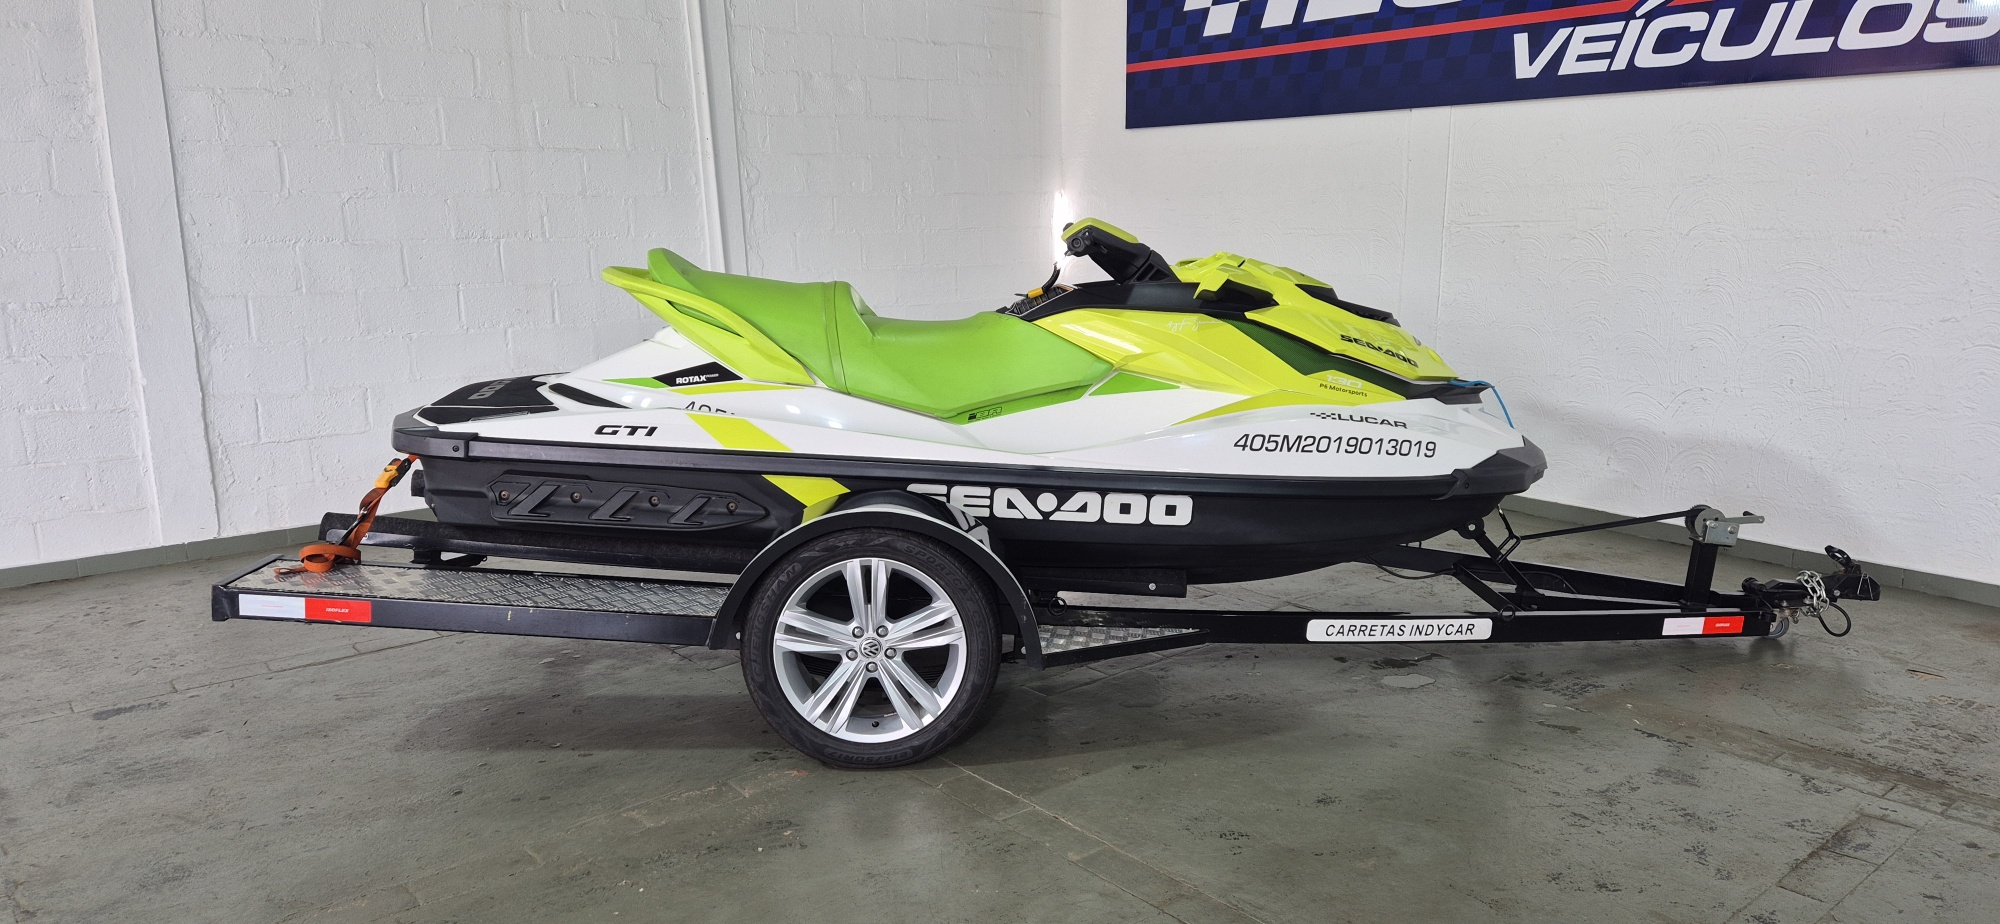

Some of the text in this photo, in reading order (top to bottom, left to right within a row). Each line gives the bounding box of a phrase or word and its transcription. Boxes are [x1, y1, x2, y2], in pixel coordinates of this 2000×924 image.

[1513, 0, 2000, 79] VEÍCULOS
[675, 374, 706, 384] ROTAX
[1327, 375, 1363, 389] 130
[1329, 385, 1368, 397] Motorsports
[1338, 413, 1408, 429] LUCAR
[594, 424, 658, 437] GTI
[1234, 433, 1437, 458] 405M2019013019
[752, 563, 799, 678] CHENGSHAN
[1325, 623, 1475, 637] CARRETAS INDYCAR
